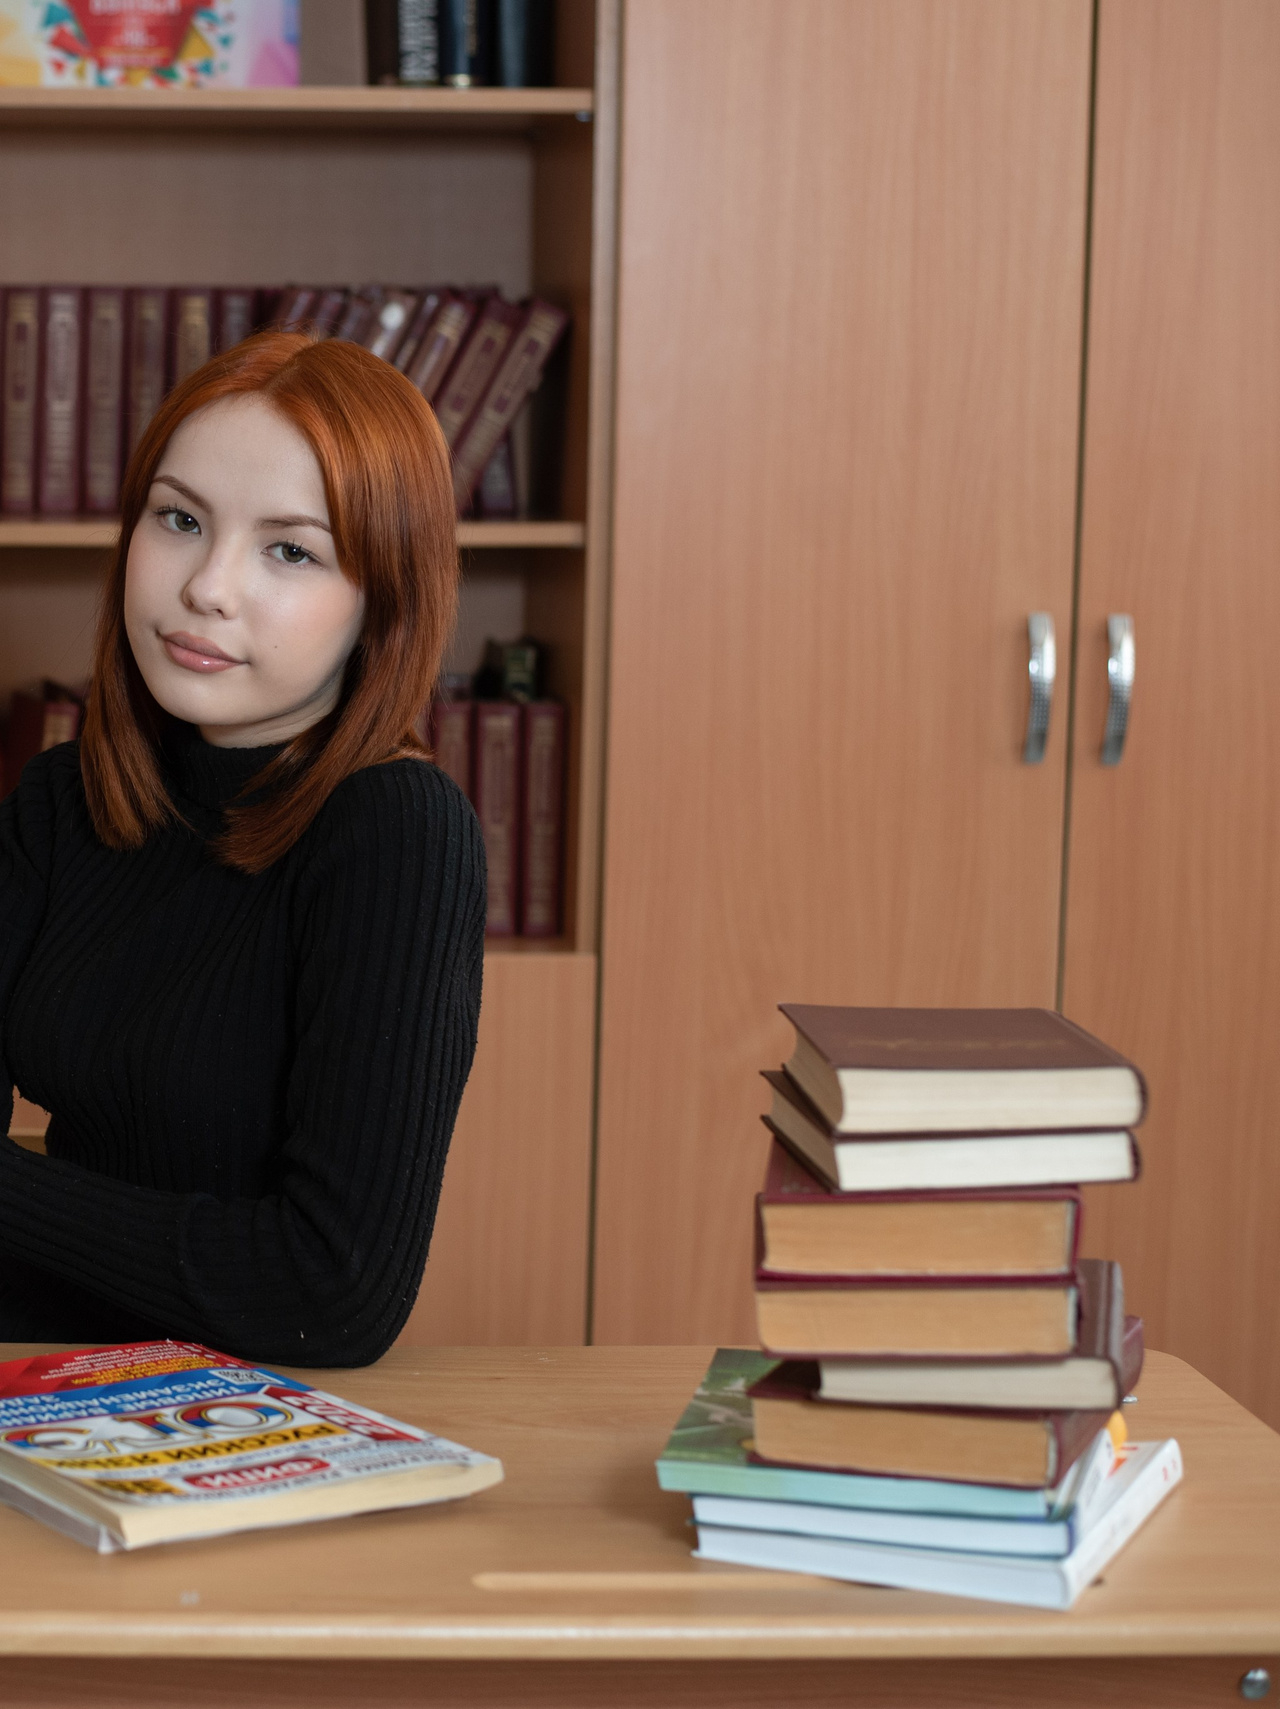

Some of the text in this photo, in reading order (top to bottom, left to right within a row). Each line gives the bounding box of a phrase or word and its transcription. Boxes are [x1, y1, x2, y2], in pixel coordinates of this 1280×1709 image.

[113, 1385, 246, 1413] ТИПОВЫЕ
[280, 1395, 396, 1435] 2022
[164, 1427, 337, 1462] РУССКИЙ
